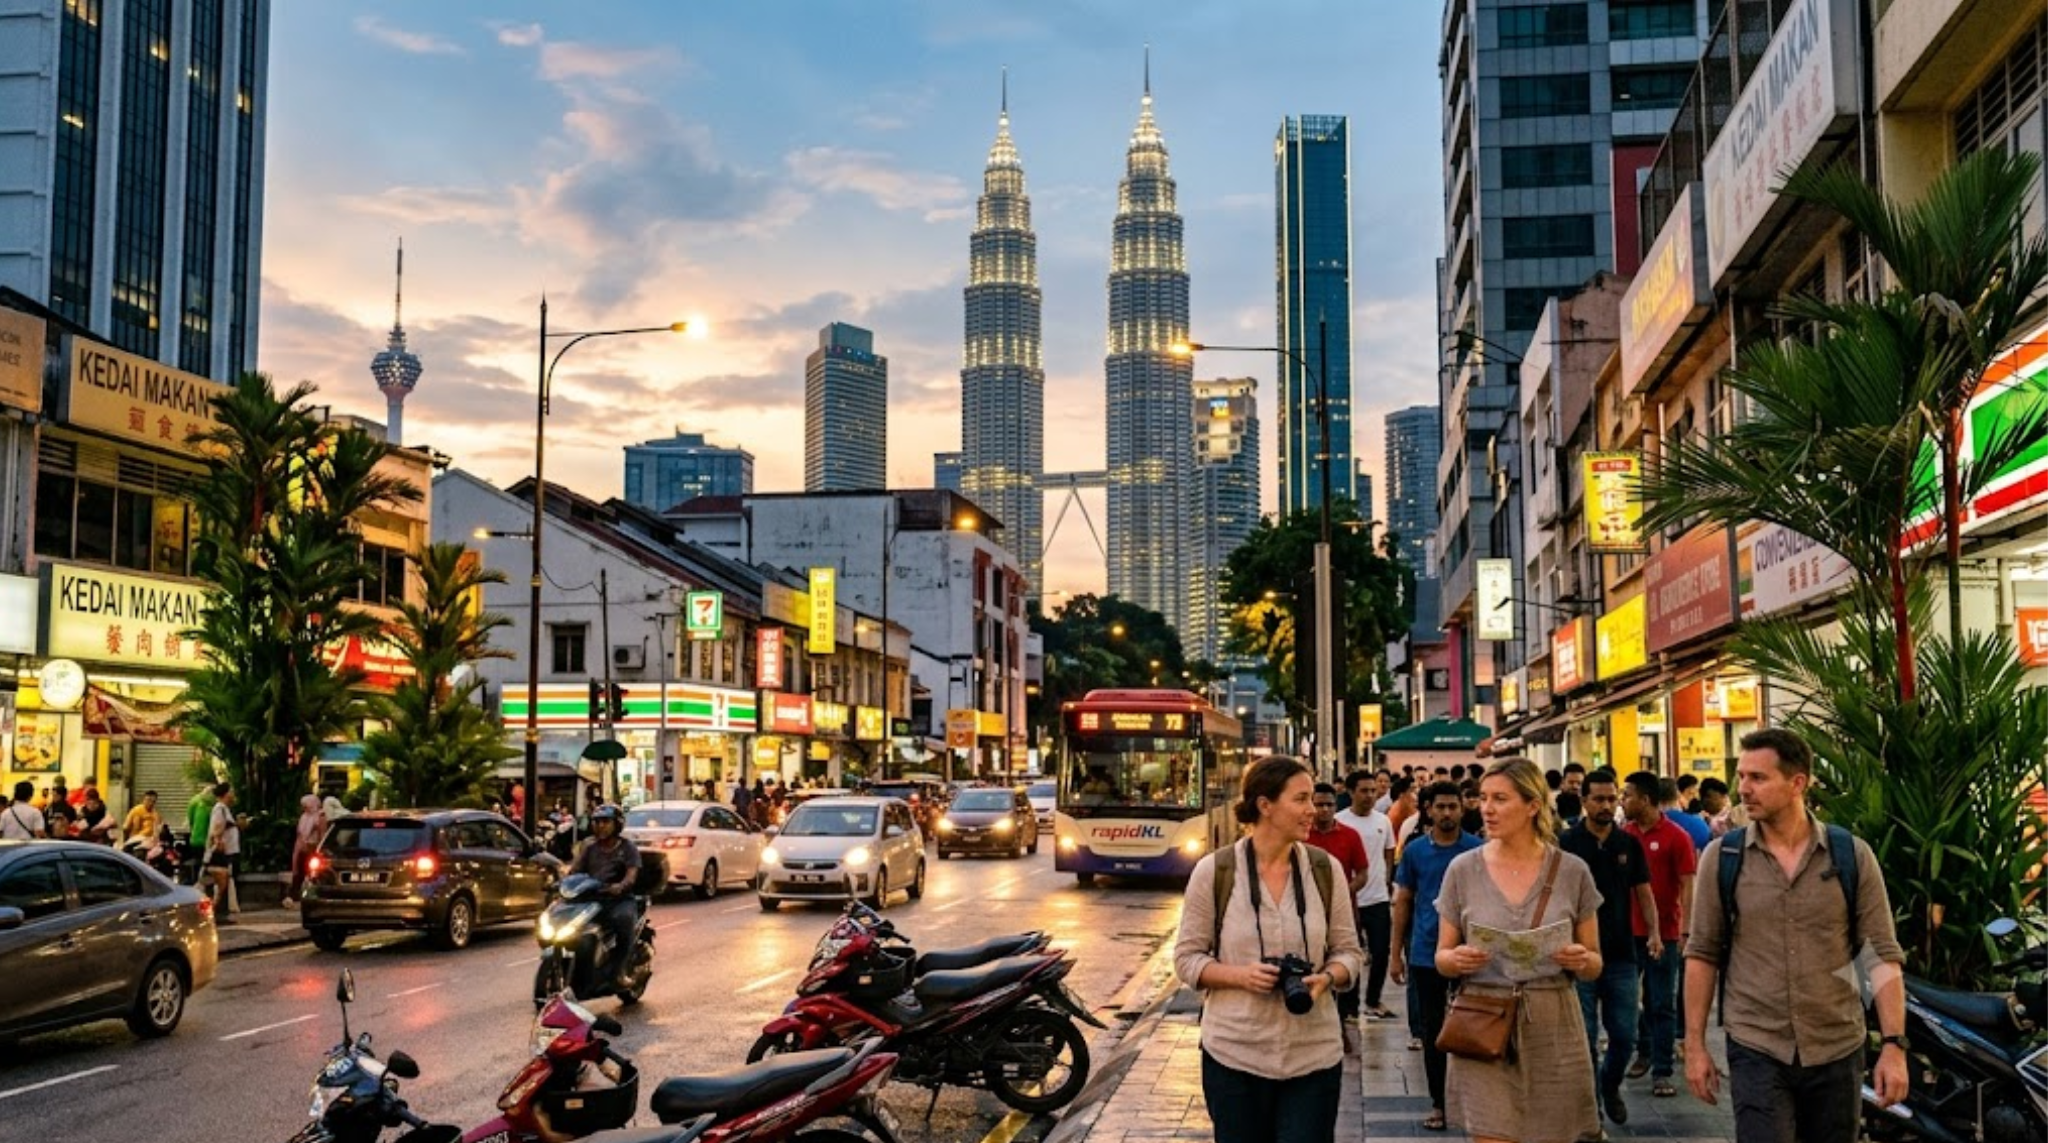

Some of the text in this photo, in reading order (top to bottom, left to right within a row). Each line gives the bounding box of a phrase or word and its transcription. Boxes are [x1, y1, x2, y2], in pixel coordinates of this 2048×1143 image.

[79, 348, 209, 419] KEDAI MAKAN
[59, 575, 198, 626] KEDAI MAKAN
[1091, 824, 1165, 841] rapidKL
